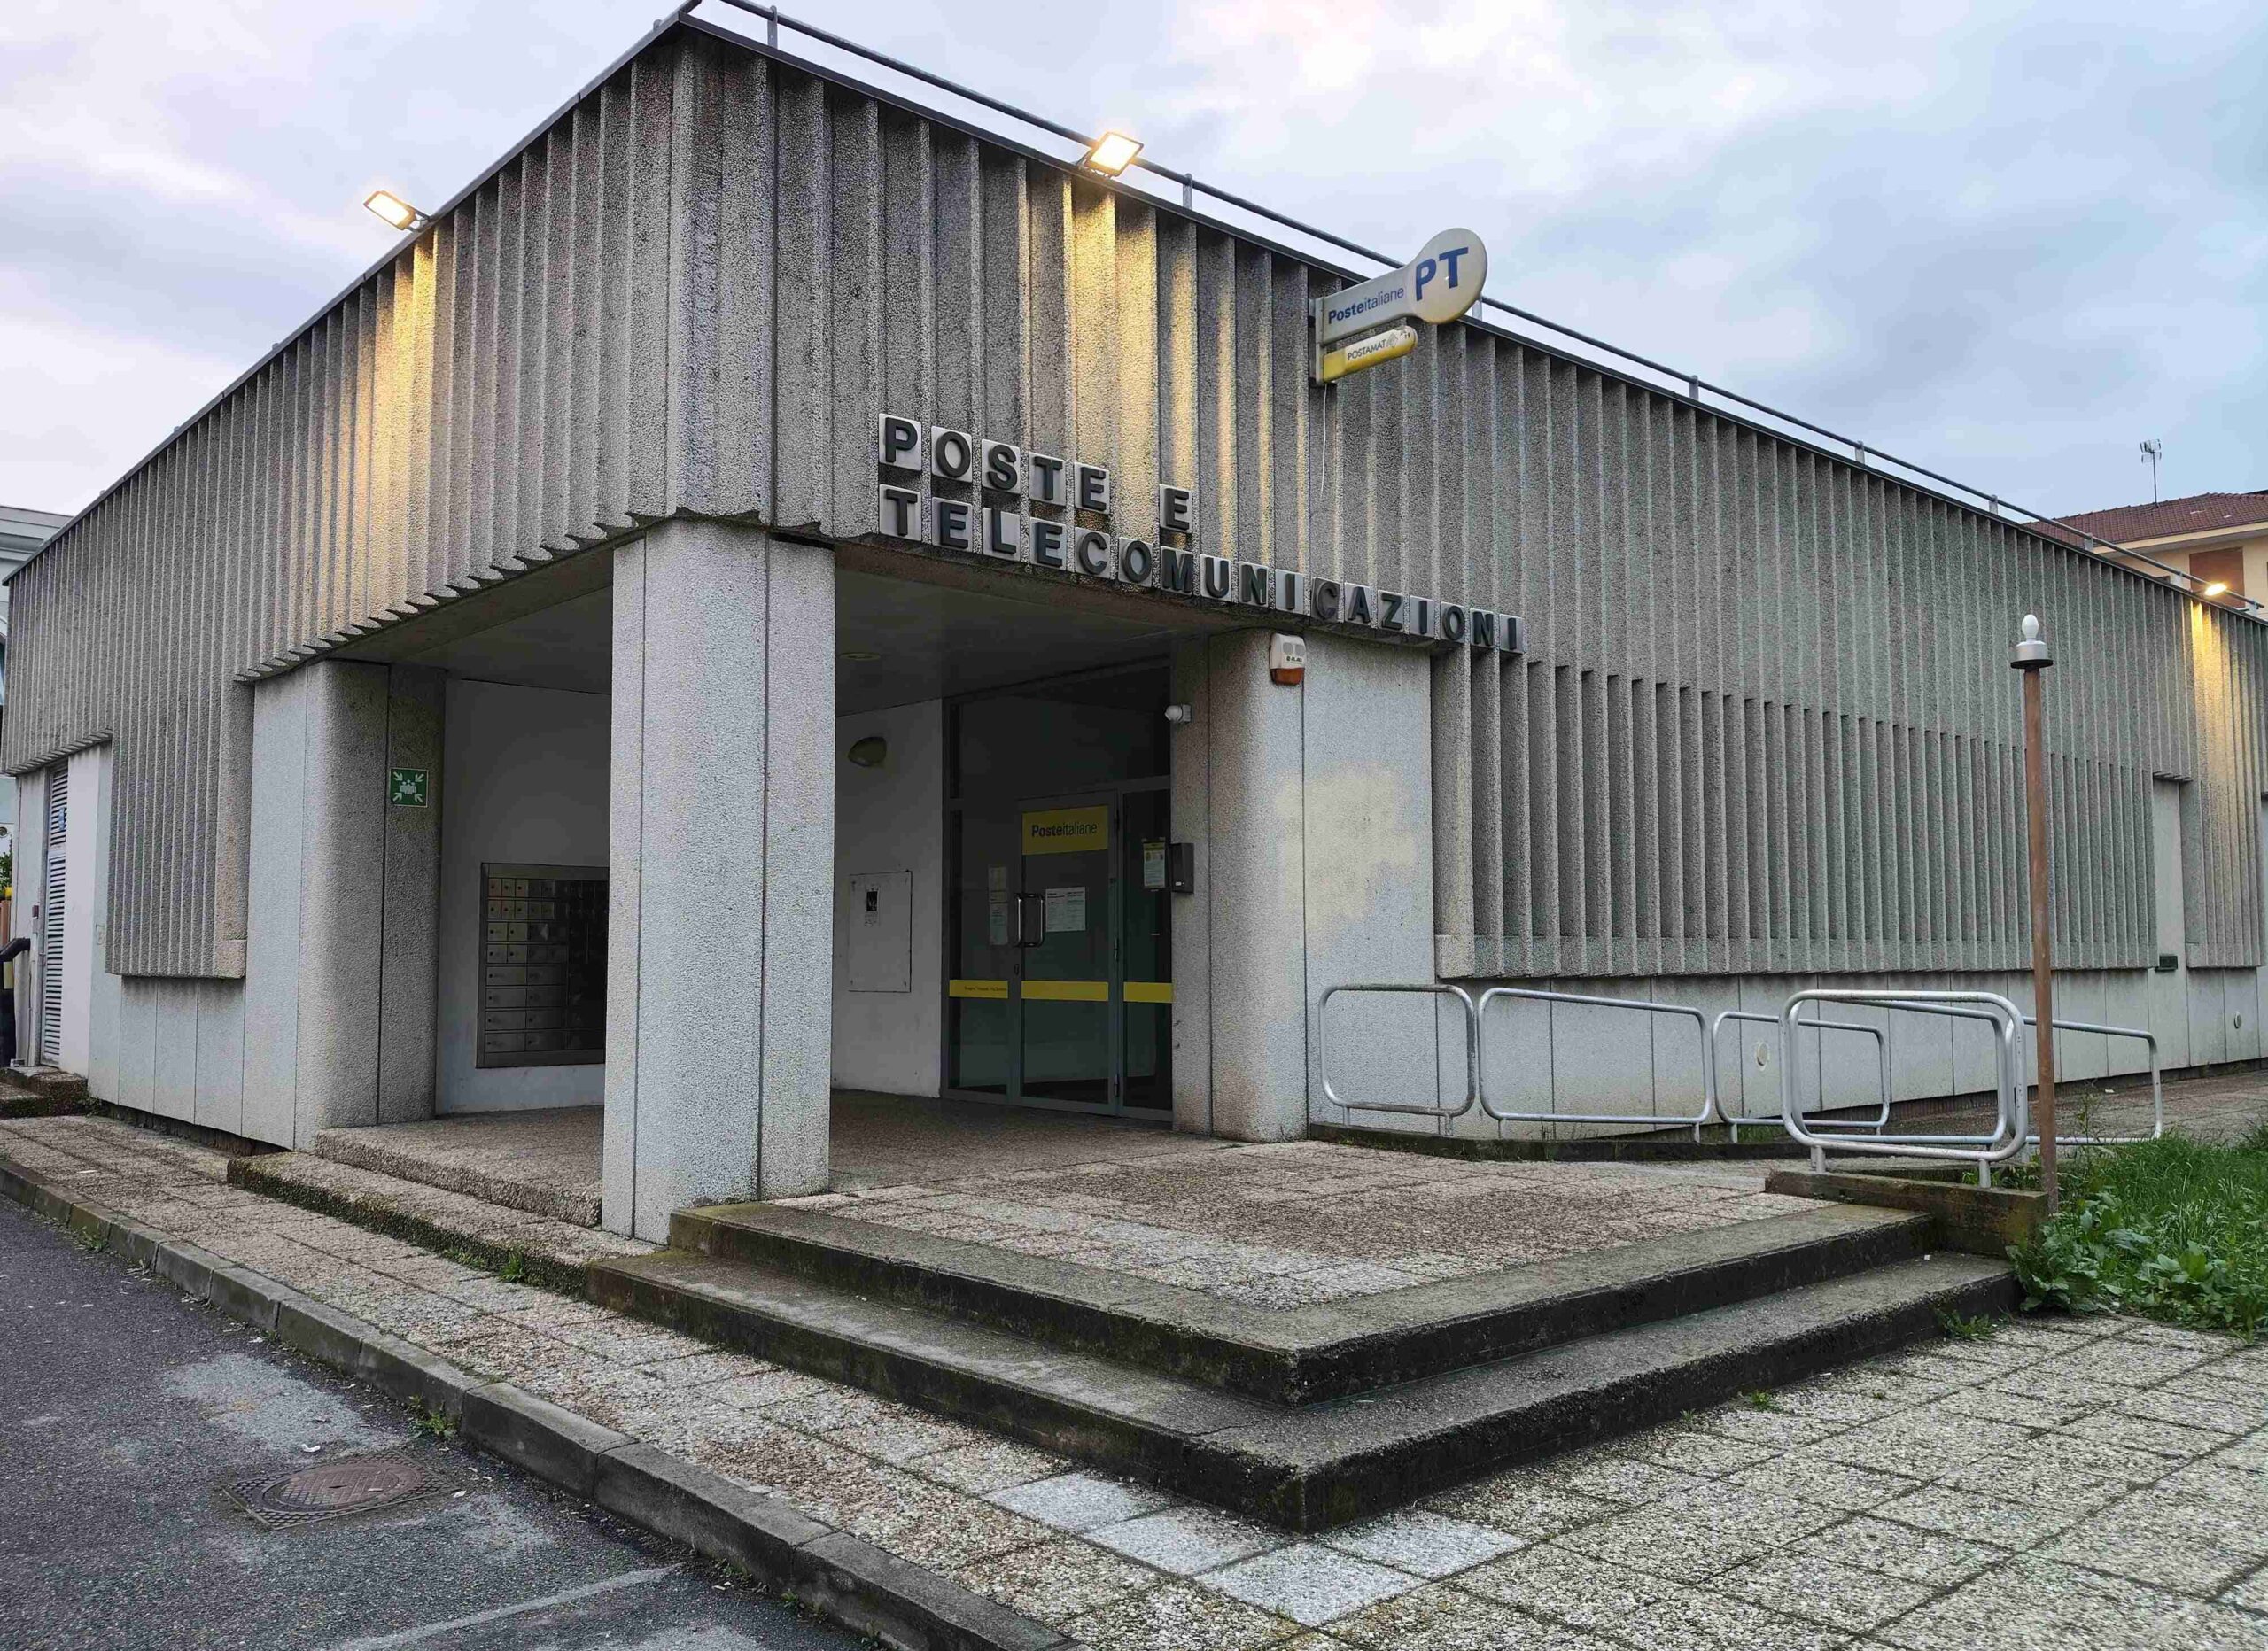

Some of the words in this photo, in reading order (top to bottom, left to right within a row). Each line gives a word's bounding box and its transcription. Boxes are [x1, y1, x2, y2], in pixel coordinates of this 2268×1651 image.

[1416, 247, 1469, 301] PT
[1328, 287, 1404, 324] Posteitaliane
[1348, 340, 1386, 360] POSTAMAT
[883, 415, 1107, 511] POSTE
[1165, 488, 1190, 531] E
[885, 487, 1519, 652] TELECOMUNICAZIONI
[1031, 822, 1098, 837] Posteitaliane
